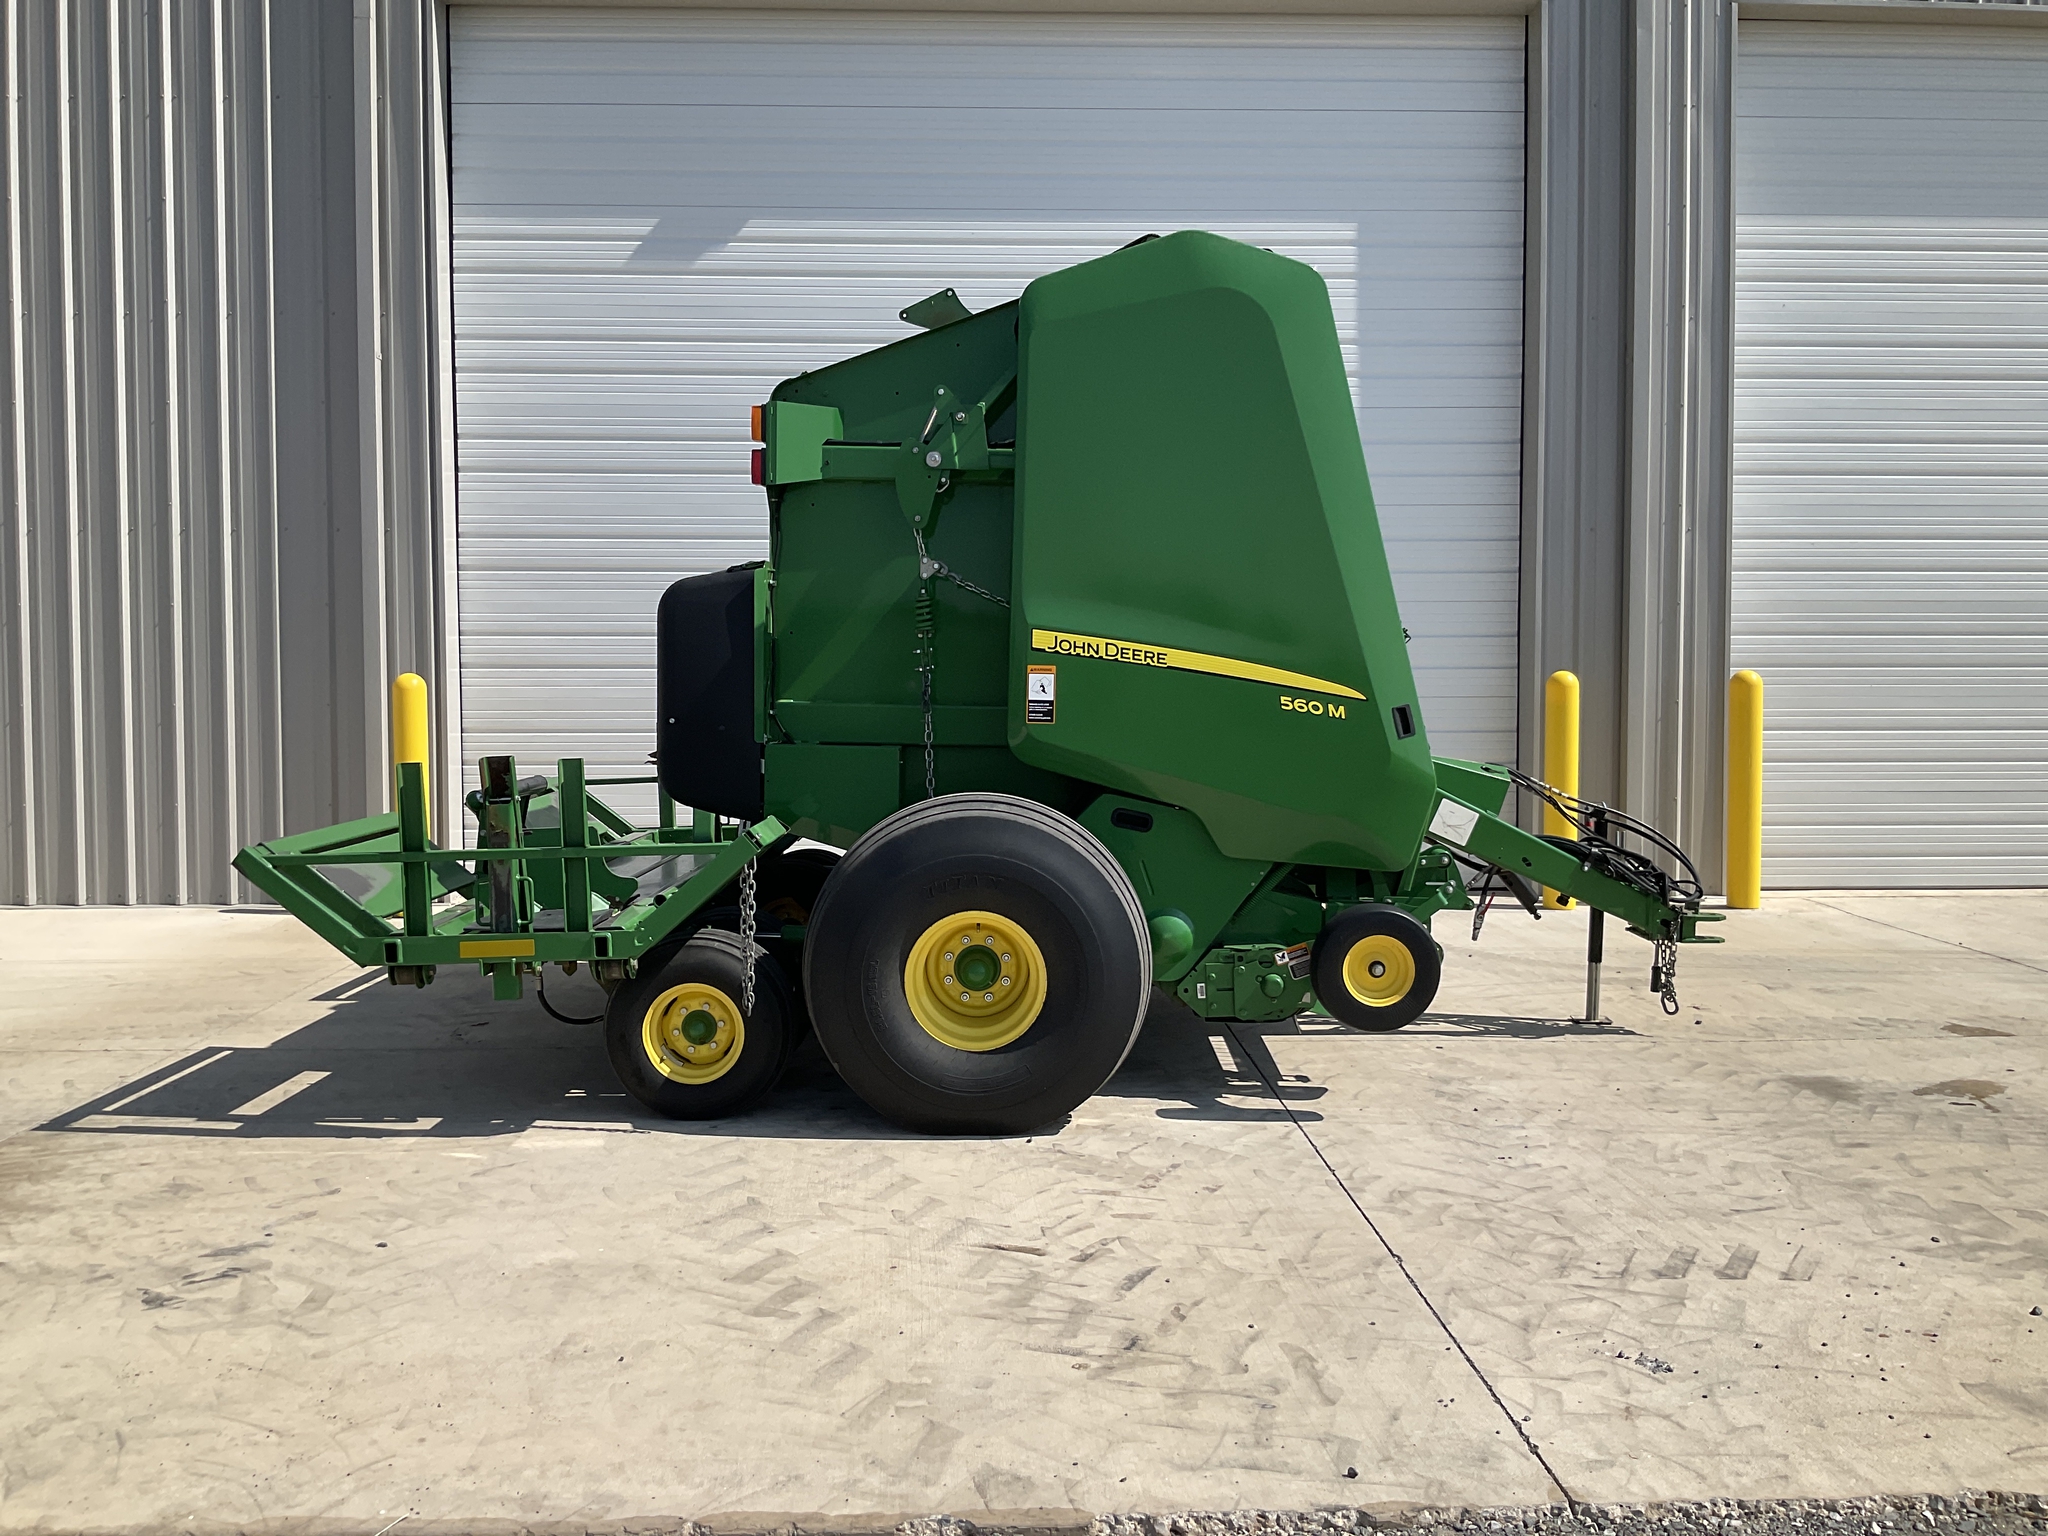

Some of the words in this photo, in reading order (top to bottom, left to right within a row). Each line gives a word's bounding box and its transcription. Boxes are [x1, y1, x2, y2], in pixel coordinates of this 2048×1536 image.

[1047, 635, 1100, 656] JOHN
[1105, 642, 1168, 665] DEERE
[1280, 695, 1324, 715] 560
[1327, 703, 1346, 719] M
